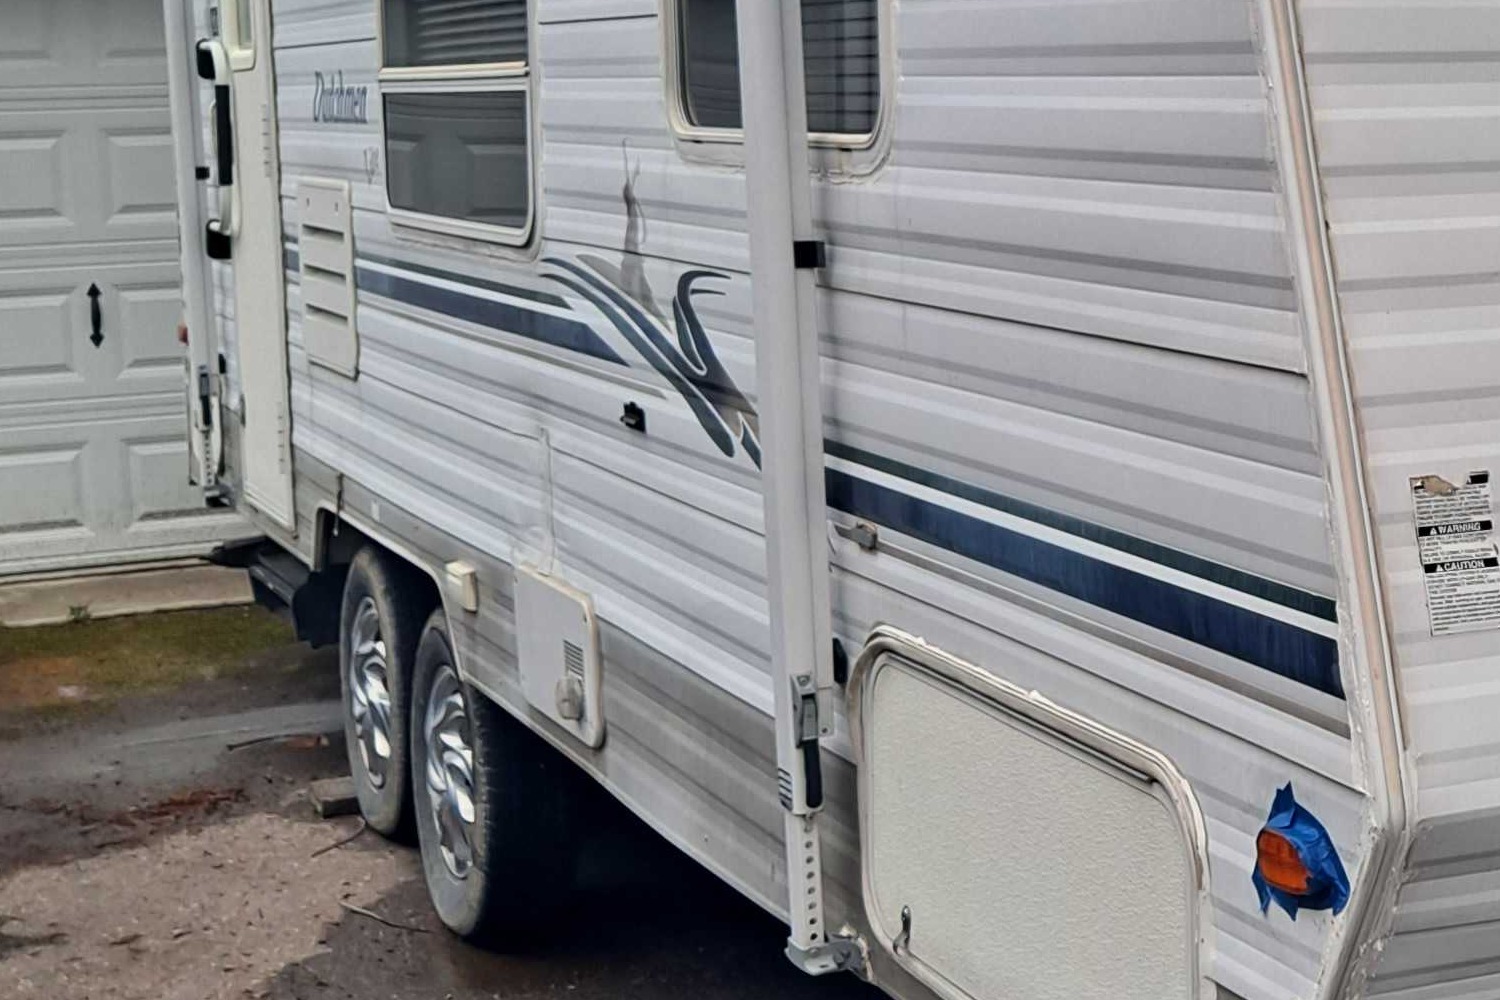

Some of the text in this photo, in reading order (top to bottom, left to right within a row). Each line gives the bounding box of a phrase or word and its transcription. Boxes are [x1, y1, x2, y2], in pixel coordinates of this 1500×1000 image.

[314, 69, 368, 123] Dutchmen
[1438, 521, 1481, 534] WARNING
[1443, 559, 1485, 571] CAUTION
